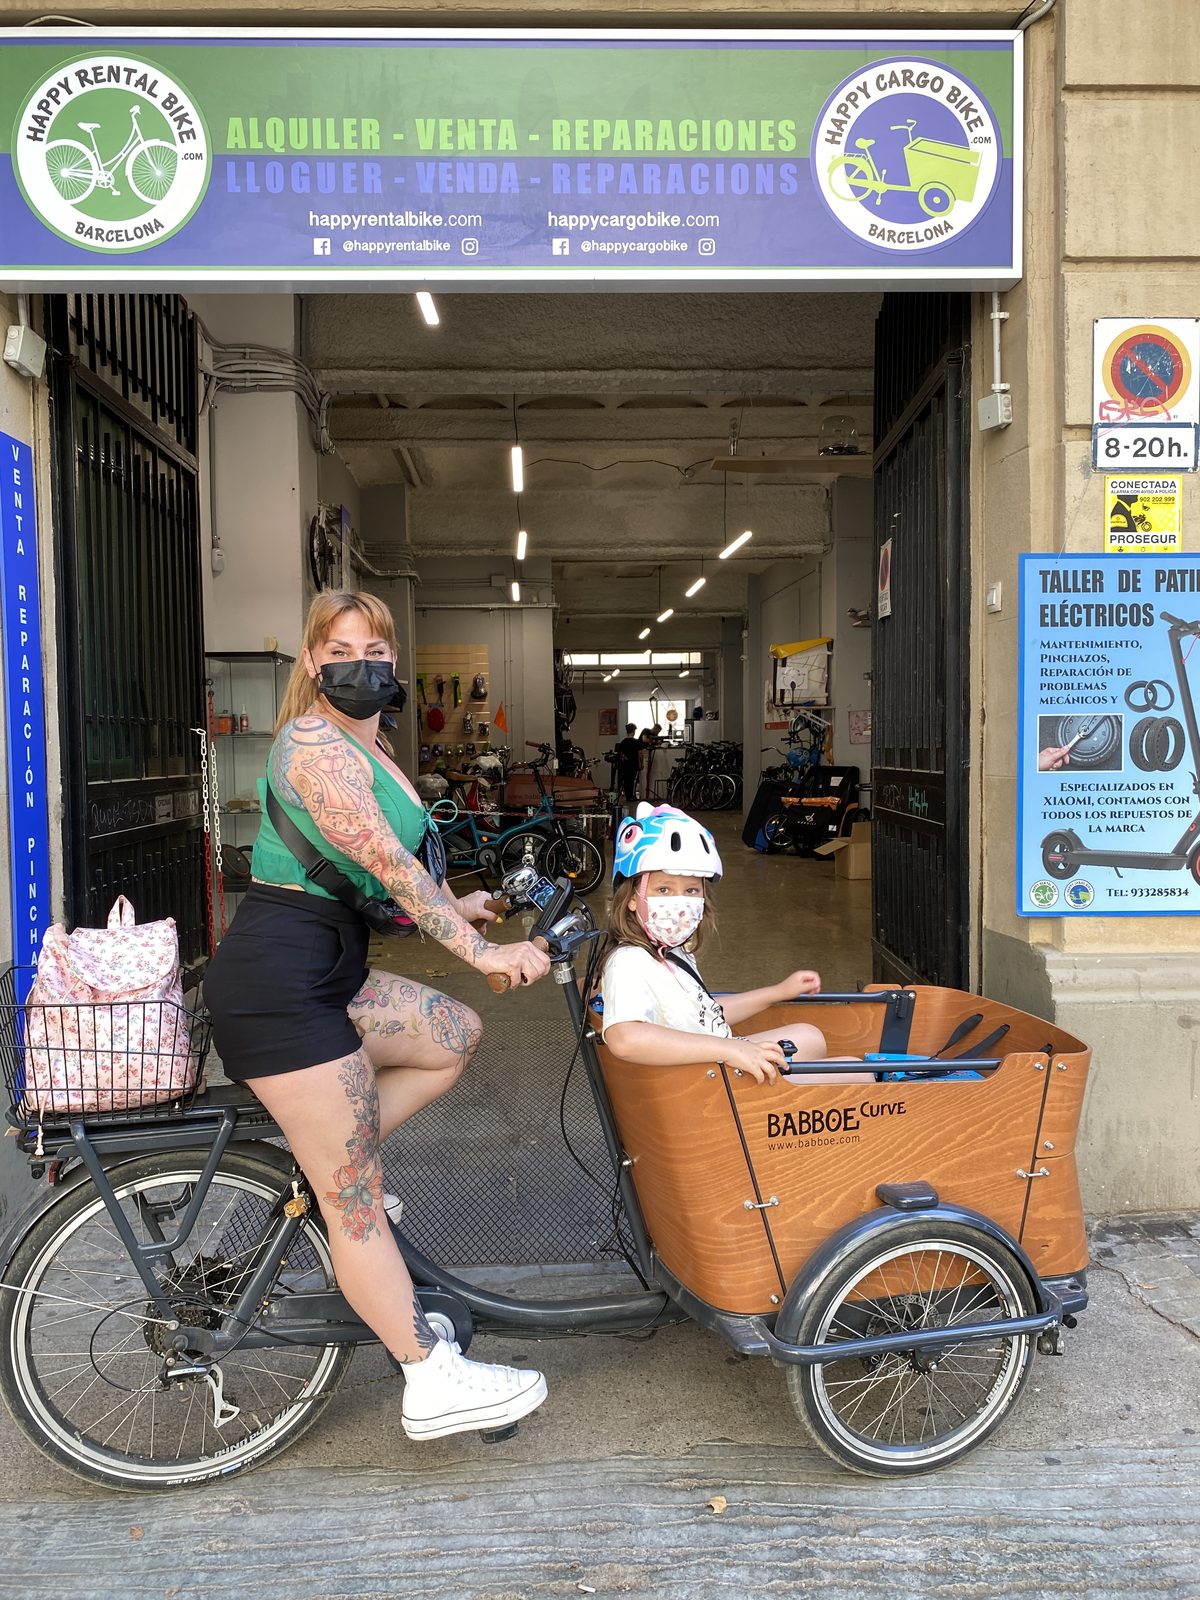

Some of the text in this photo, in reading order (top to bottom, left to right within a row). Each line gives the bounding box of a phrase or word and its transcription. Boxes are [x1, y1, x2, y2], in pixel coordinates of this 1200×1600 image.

[26, 65, 203, 161] HAPPY RENTAL BIKE .COM
[825, 68, 991, 147] HAPPY CARGO BIKE .COM
[226, 116, 381, 151] ALQUILER
[415, 117, 517, 151] VENTA
[552, 118, 797, 152] REPARACIONES
[226, 160, 383, 194] LLOGUER
[416, 161, 520, 194] VENDA
[552, 162, 798, 195] REPARACIONS
[309, 211, 482, 231] happyrentalbike.com
[547, 211, 720, 231] happycargobike.com
[75, 218, 165, 244] BARCELONA
[868, 219, 954, 245] BARCELONA
[343, 239, 451, 254] @happyrentalbike
[580, 239, 688, 255] @happycargobike
[1110, 480, 1177, 489] CONECTADA
[11, 444, 25, 556] VENTA
[1109, 534, 1177, 544] PROSEGUR
[1039, 569, 1104, 593] TALLER
[1118, 569, 1142, 593] DE
[1039, 599, 1155, 628] ELÉCTRICOS
[1040, 639, 1142, 650] MANTENIMIENTO,
[1040, 653, 1110, 664] PINCHAZOS,
[1040, 666, 1132, 677] REPARACIÓN DE
[1040, 681, 1107, 691] PROBLEMAS
[18, 584, 35, 808] REPARACIÓN
[1039, 694, 1118, 705] MECÁNICOS Y
[1060, 782, 1174, 792] ESPECIALIZADOS EN
[1043, 796, 1190, 807] XIAOMI, CONTAMOS CON
[1041, 810, 1192, 820] TODOS LOS REPUESTOS DE
[1088, 824, 1146, 833] LA MARCA
[1106, 888, 1189, 897] TEL: 933285834
[767, 1107, 860, 1138] BABBOE
[768, 1134, 861, 1151] www.babboe.com
